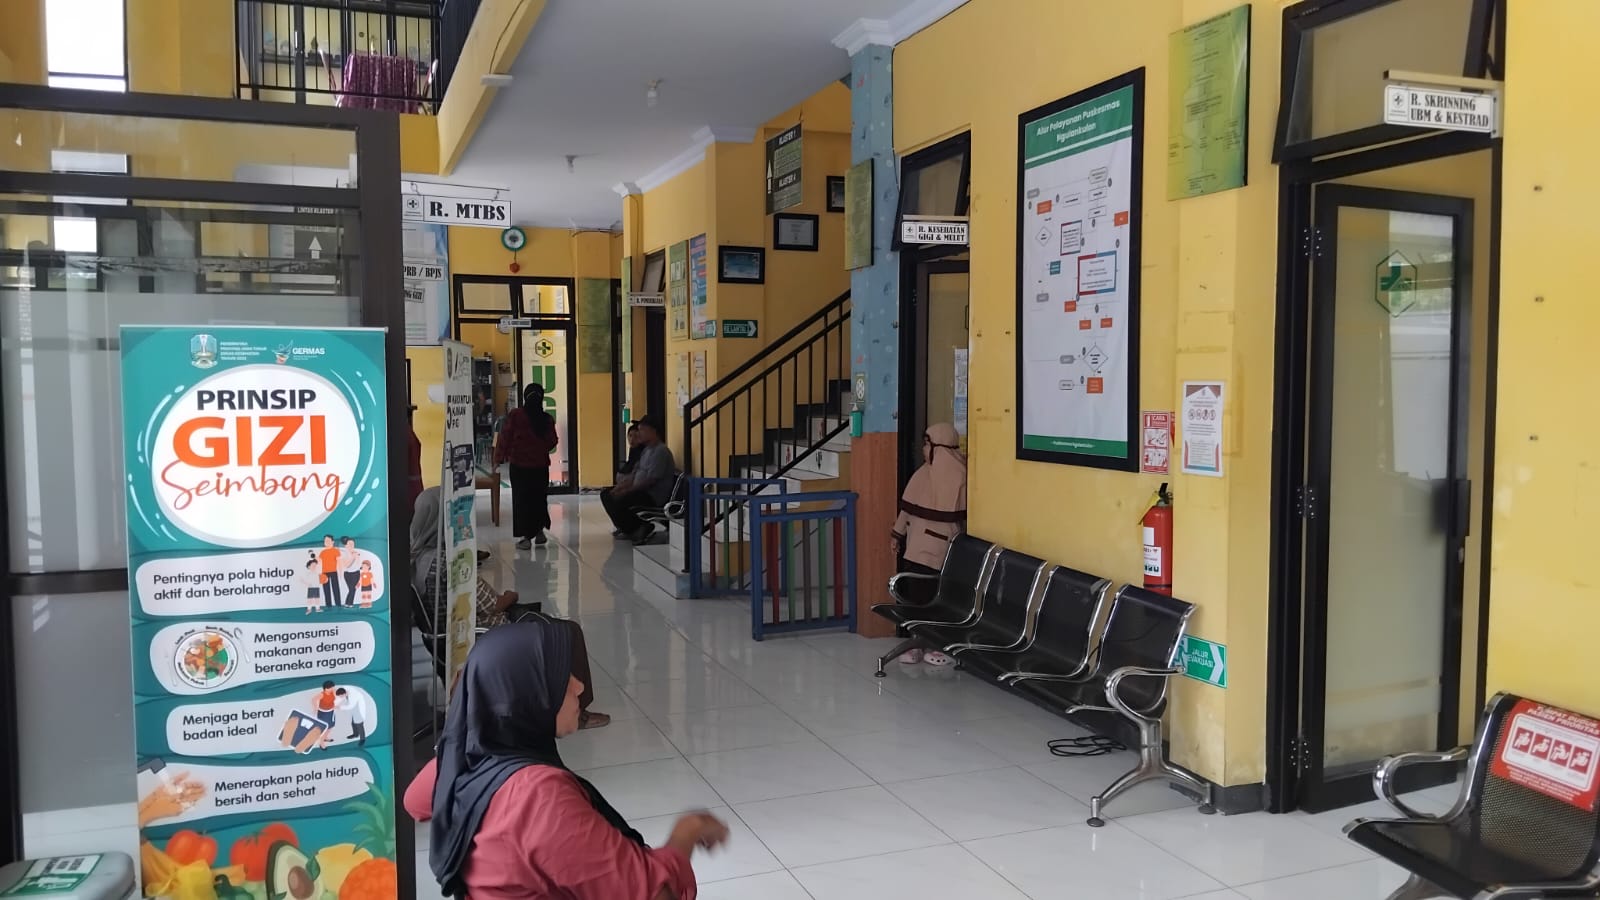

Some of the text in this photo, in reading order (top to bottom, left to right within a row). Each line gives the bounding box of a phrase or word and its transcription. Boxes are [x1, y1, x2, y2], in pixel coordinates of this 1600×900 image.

[1411, 93, 1476, 111] R. SKRINNING
[1050, 114, 1082, 132] Pelayanan
[1083, 100, 1120, 120] Puskesmas
[1410, 108, 1489, 127] UBM & KESTRAD
[430, 201, 505, 221] R. MTBS
[426, 268, 442, 279] BPJS
[197, 389, 316, 410] PRINSIP
[172, 415, 326, 468] GIZI
[161, 459, 344, 512] Seimbang
[153, 567, 294, 585] Pentingnya pola hidup
[154, 583, 290, 600] aktif dan berolahraga
[254, 626, 339, 644] Mengonsumsi
[254, 640, 362, 659] makanan dengan
[255, 656, 356, 674] beraneka ragam
[183, 708, 274, 727] Menjaga berat
[183, 724, 258, 741] badan ideal
[214, 764, 359, 792] Menerapkan pola hidup
[215, 786, 316, 807] bersih dan sehat
